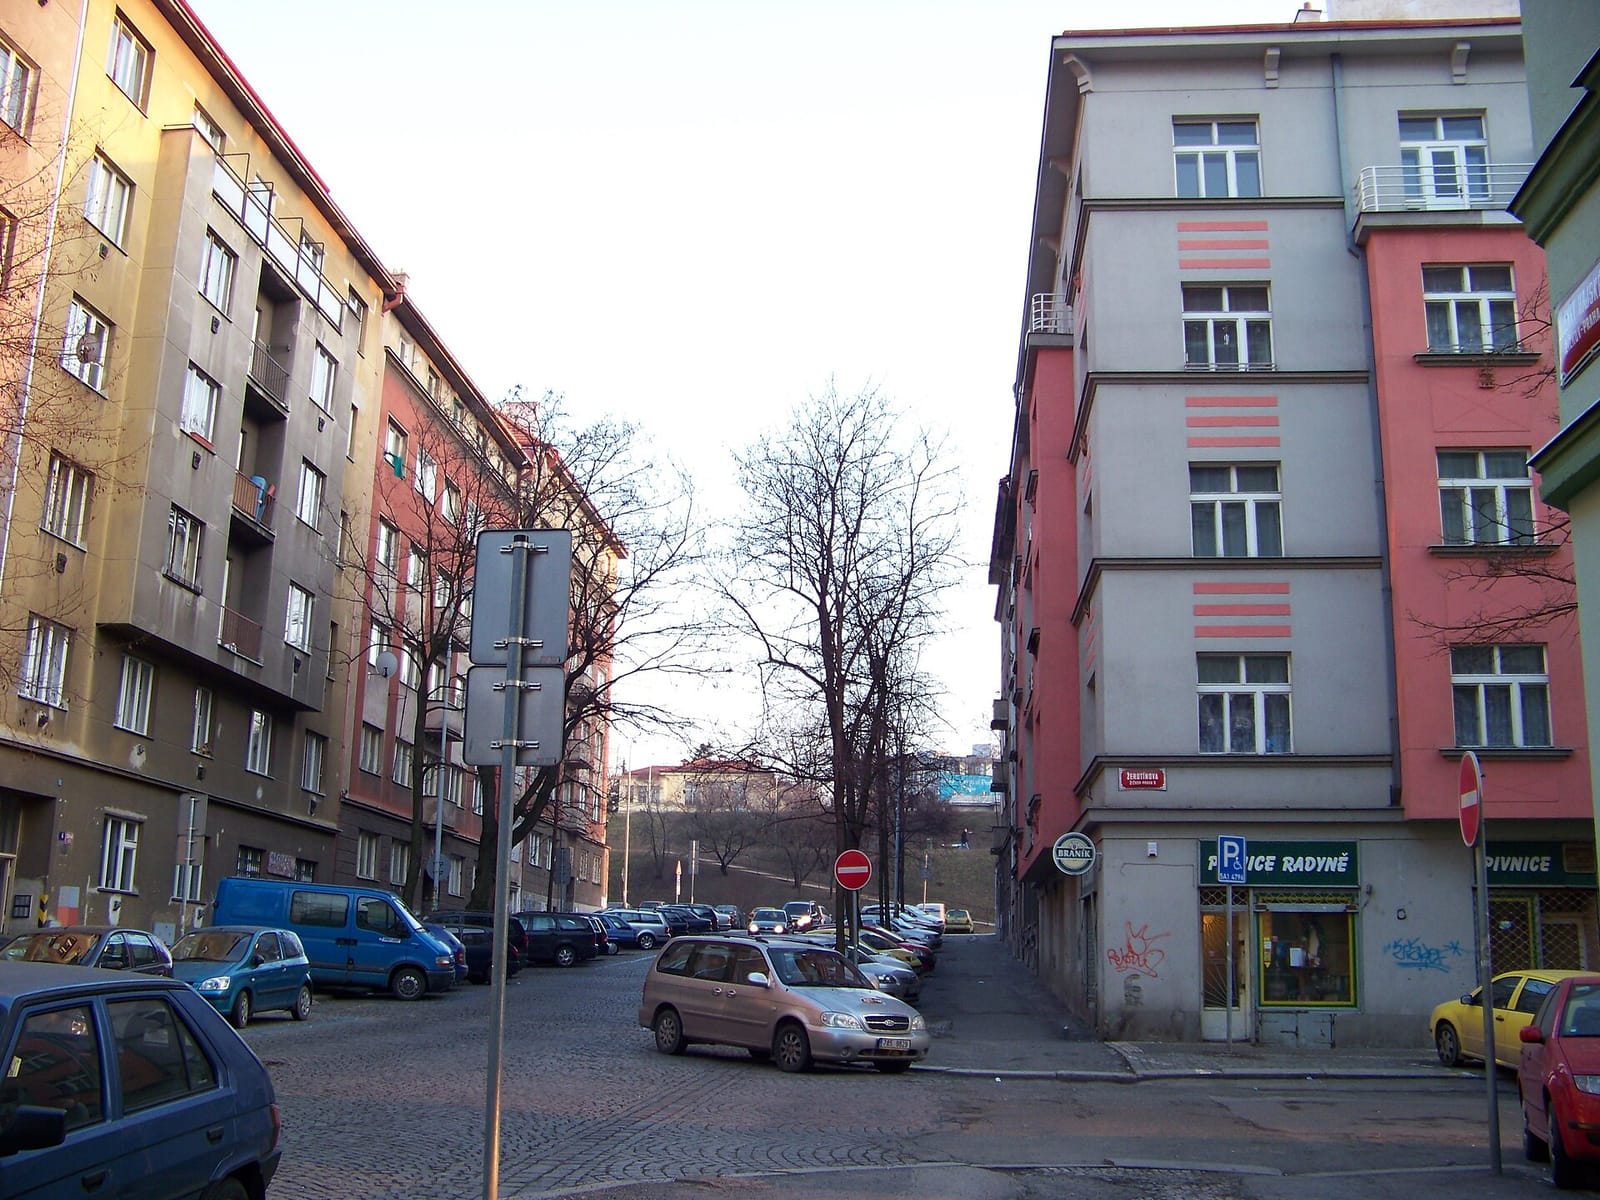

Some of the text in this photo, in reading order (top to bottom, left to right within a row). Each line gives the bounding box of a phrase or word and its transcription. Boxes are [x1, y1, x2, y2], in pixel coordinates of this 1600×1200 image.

[1057, 848, 1091, 858] BRANÍK
[1207, 852, 1349, 873] PICE RADYNĚ
[1223, 840, 1240, 868] P
